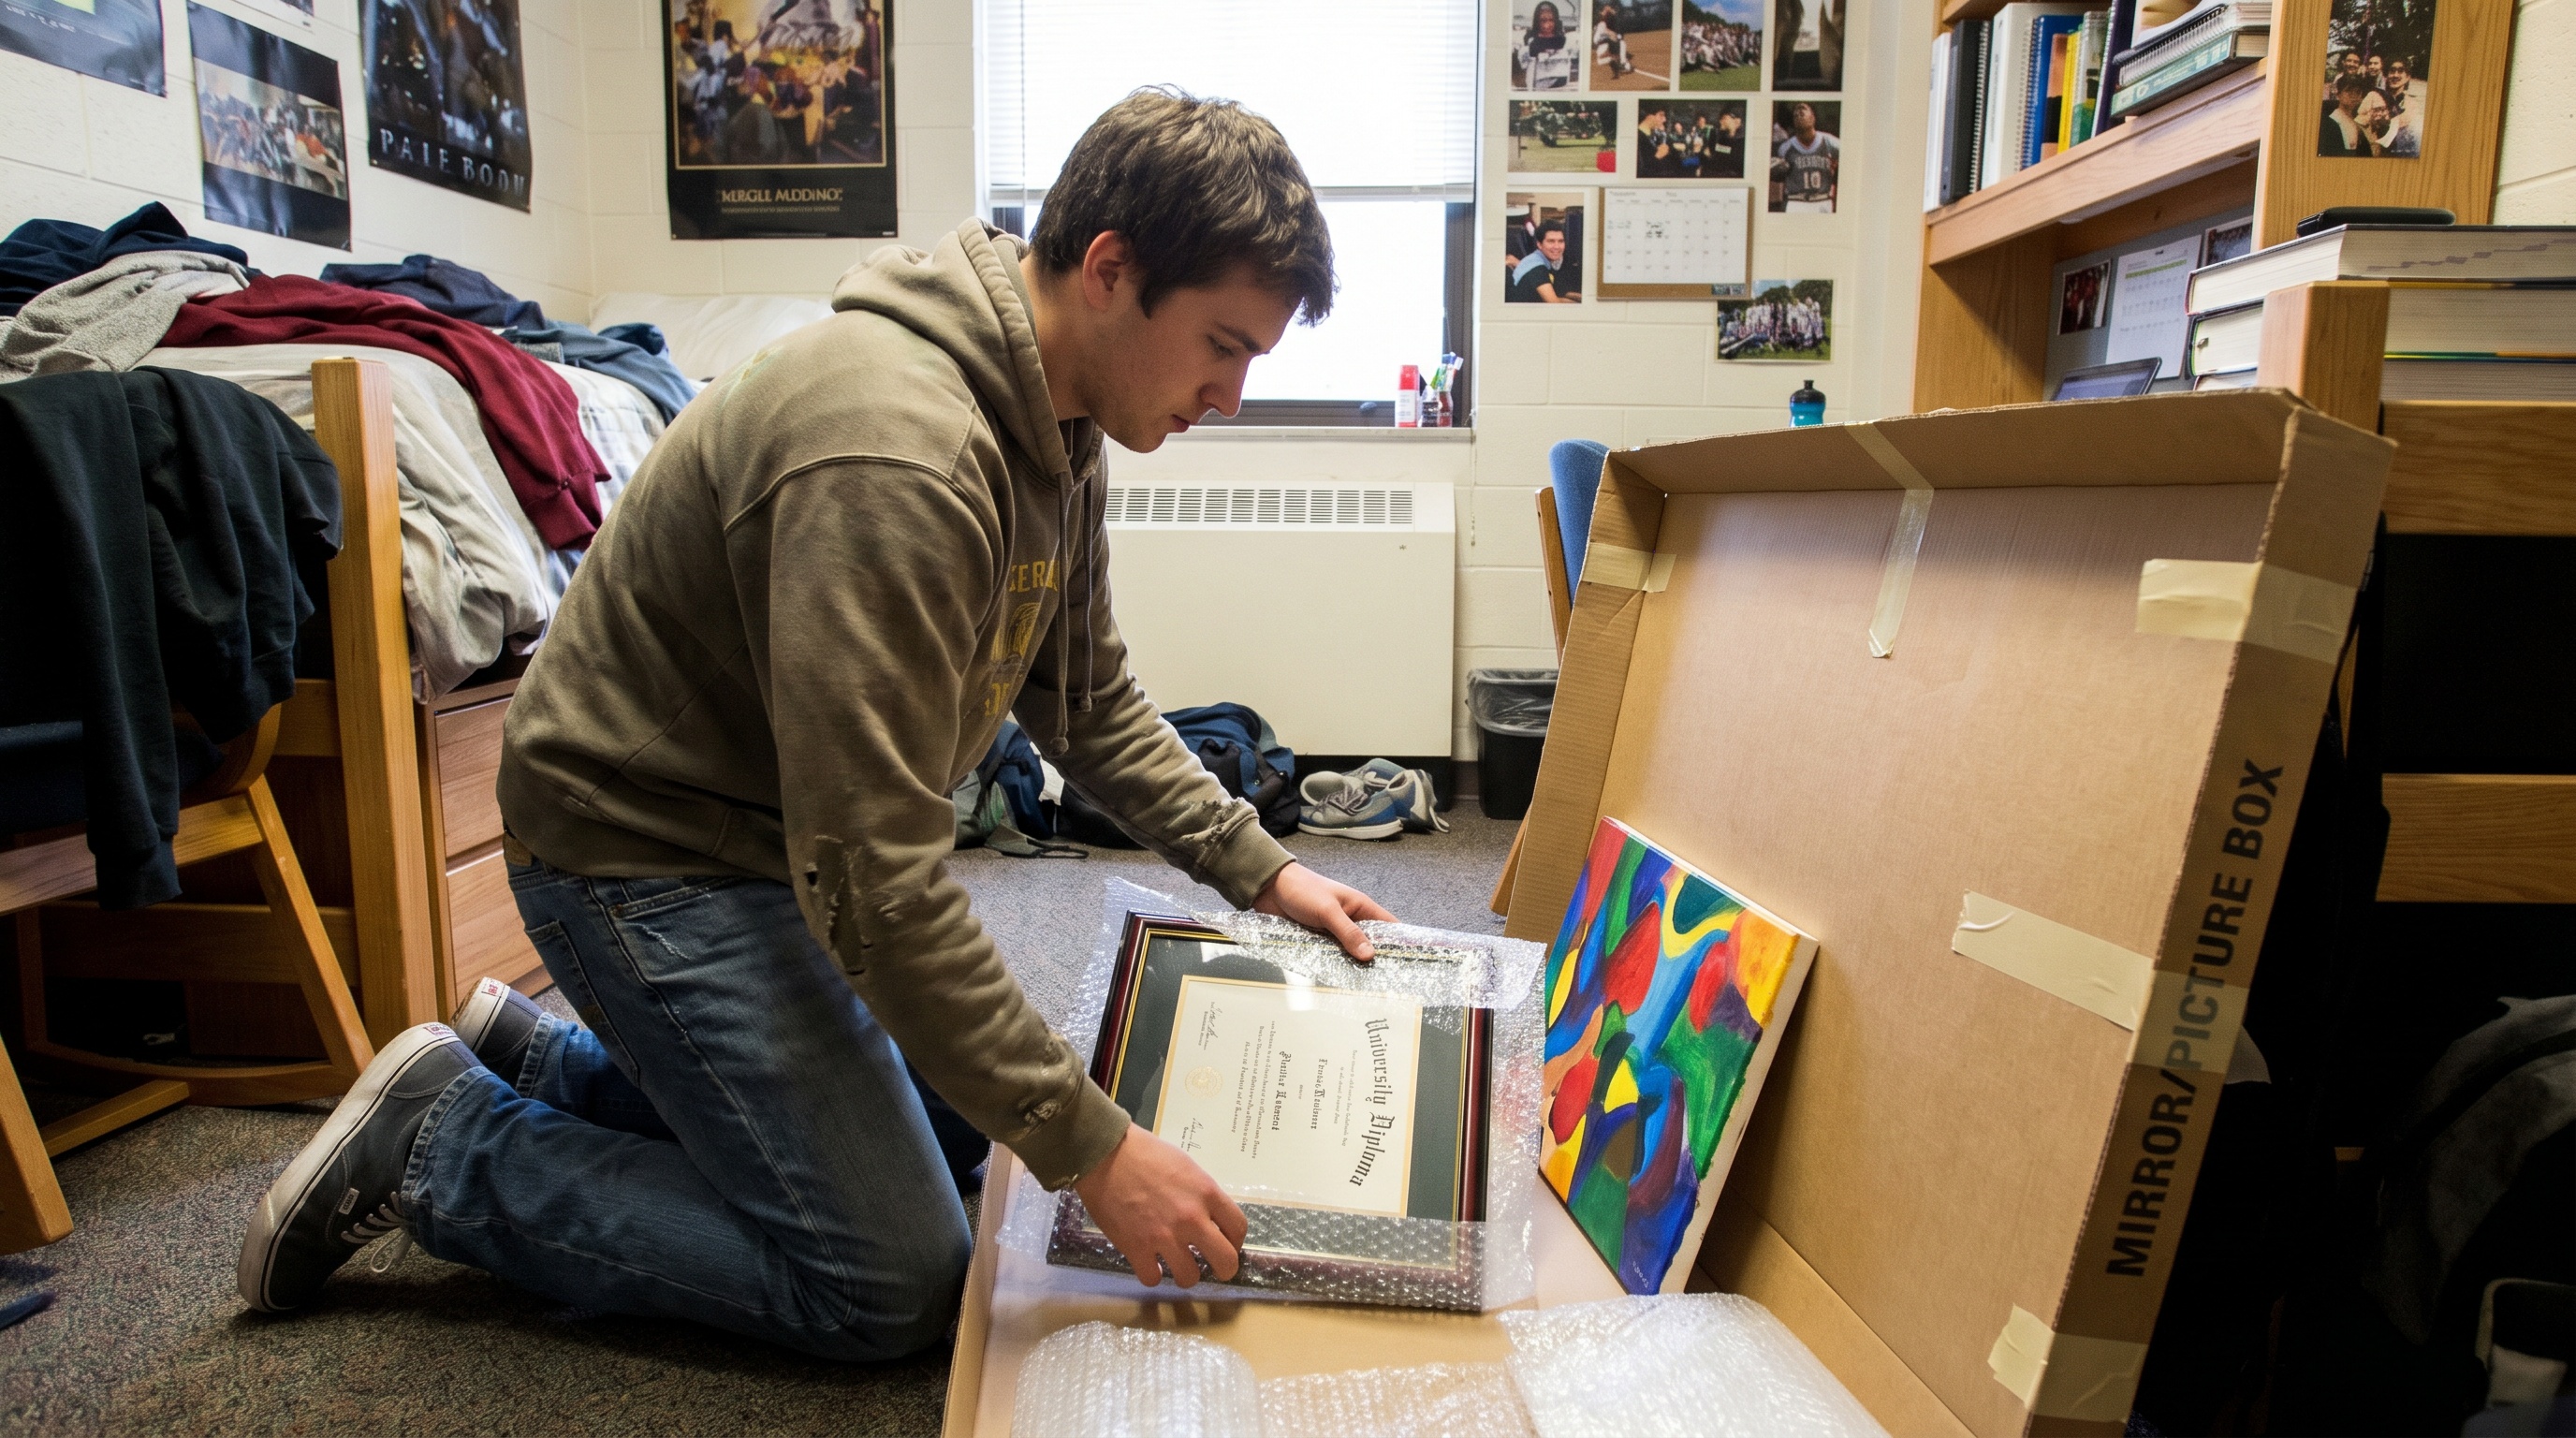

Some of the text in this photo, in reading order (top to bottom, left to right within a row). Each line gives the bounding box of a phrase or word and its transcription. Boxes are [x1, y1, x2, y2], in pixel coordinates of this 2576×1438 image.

[1803, 170, 1822, 190] 10
[2105, 757, 2285, 1278] MIRROR/PICTURE BOX
